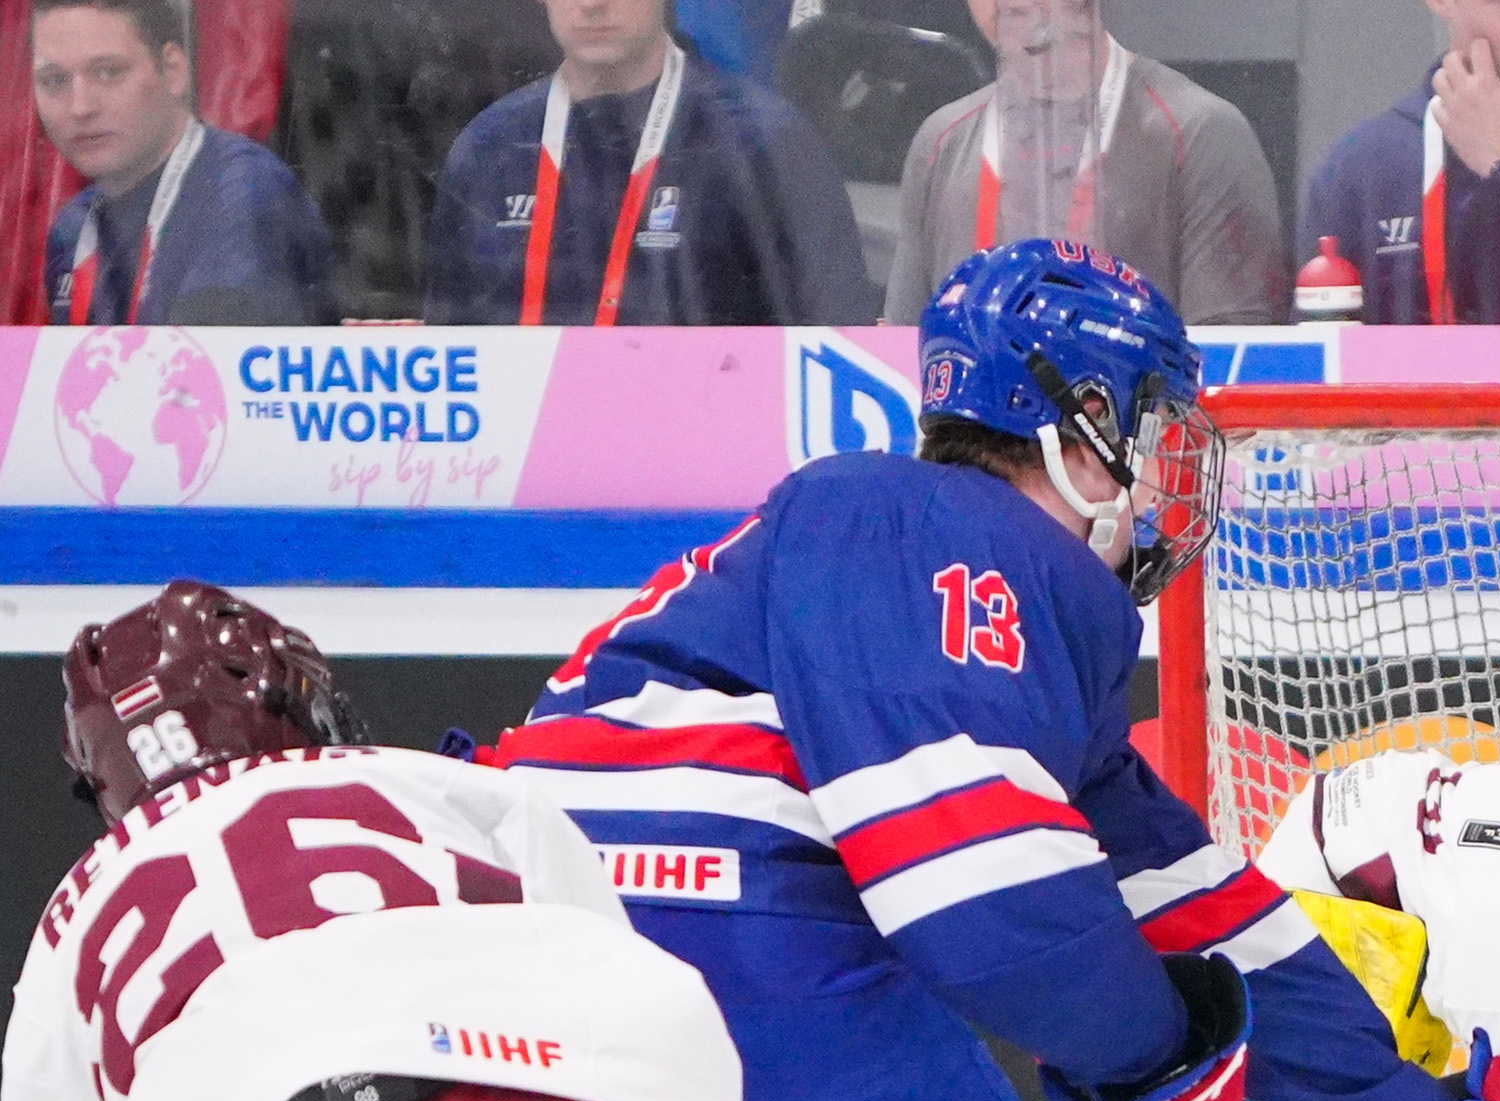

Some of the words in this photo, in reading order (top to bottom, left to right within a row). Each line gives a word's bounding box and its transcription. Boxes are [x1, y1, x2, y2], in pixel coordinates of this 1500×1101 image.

[1052, 240, 1150, 298] USA
[239, 345, 478, 393] CHANGE
[923, 360, 953, 404] 13
[241, 401, 284, 419] THE
[289, 401, 480, 443] WORLD
[328, 454, 382, 507] sip
[396, 426, 434, 508] by
[447, 447, 499, 500] sip
[933, 562, 1026, 673] 13
[127, 710, 199, 782] 26
[614, 853, 722, 892] IIHF
[74, 782, 440, 1098] 26
[458, 1029, 563, 1069] IIHF
